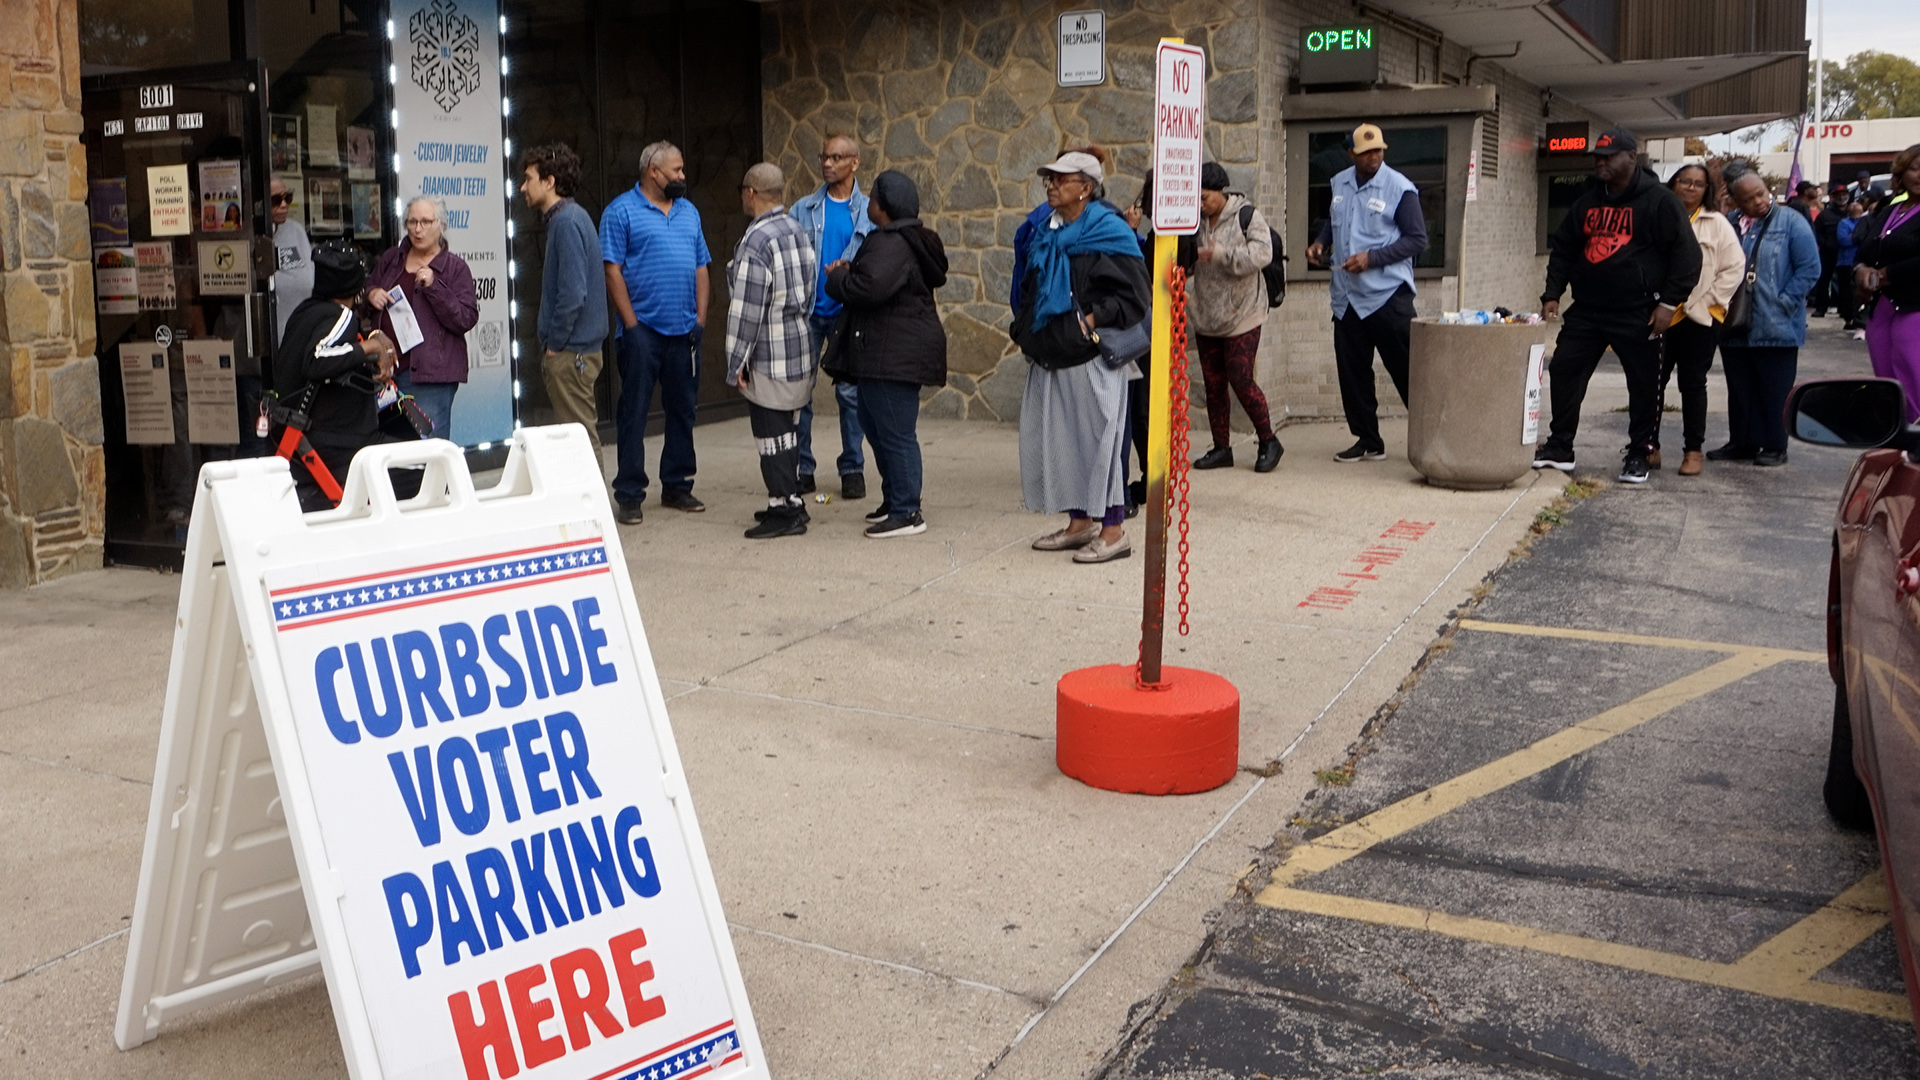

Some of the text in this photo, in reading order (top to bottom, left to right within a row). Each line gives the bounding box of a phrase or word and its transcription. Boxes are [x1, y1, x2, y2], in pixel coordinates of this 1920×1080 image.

[1076, 20, 1088, 31] NO
[1063, 32, 1100, 46] TRESPASSING
[1306, 28, 1371, 52] OPEN
[1172, 60, 1190, 94] NO
[142, 85, 171, 106] 6001
[104, 113, 203, 136] WEST CAPITOL DRIVE
[1160, 104, 1199, 139] PARKING
[417, 141, 489, 166] CUSTOM JEWELRY
[1549, 137, 1586, 150] CLOSED
[155, 186, 182, 194] WORKER
[422, 176, 487, 196] DIAMOND TEETH
[153, 207, 186, 216] ENTRANCE
[155, 197, 183, 205] TRAINING
[1597, 208, 1631, 236] NBA
[1529, 389, 1537, 399] NO
[314, 596, 618, 744] CURBSIDE
[387, 711, 602, 848] VOTER
[382, 805, 662, 979] PARKING
[447, 927, 667, 1080] HERE
